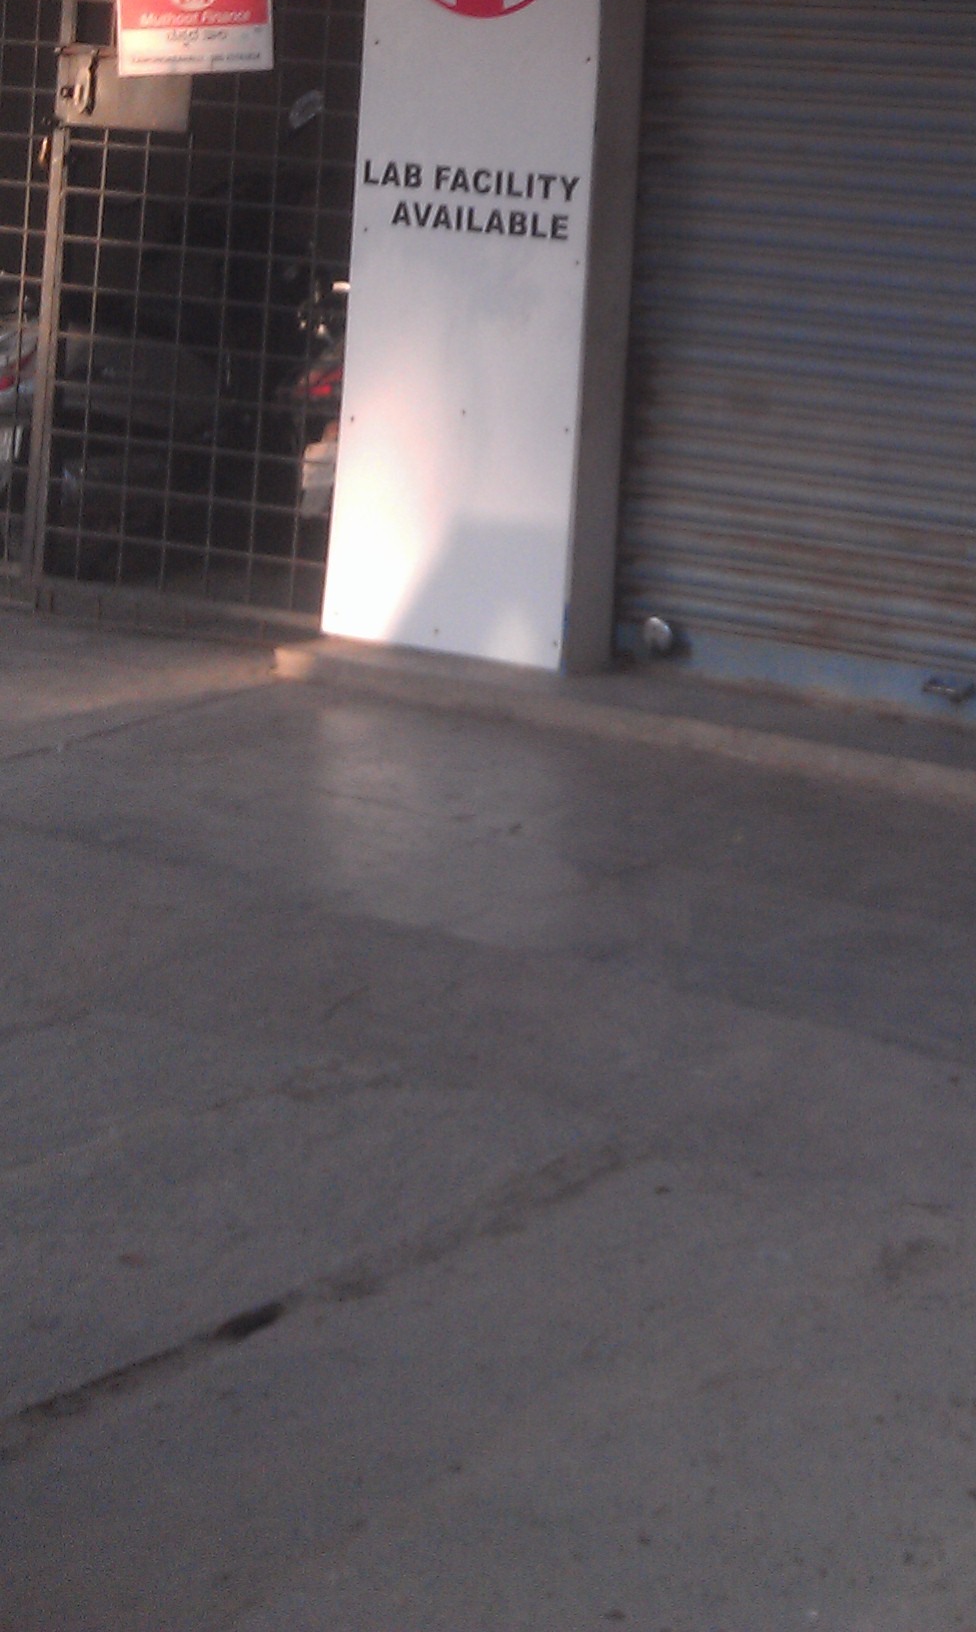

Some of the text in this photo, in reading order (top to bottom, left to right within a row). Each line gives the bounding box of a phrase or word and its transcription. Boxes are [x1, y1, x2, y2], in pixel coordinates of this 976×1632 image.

[363, 159, 580, 202] LAB FACILITY
[391, 200, 569, 240] AVAILABLE
